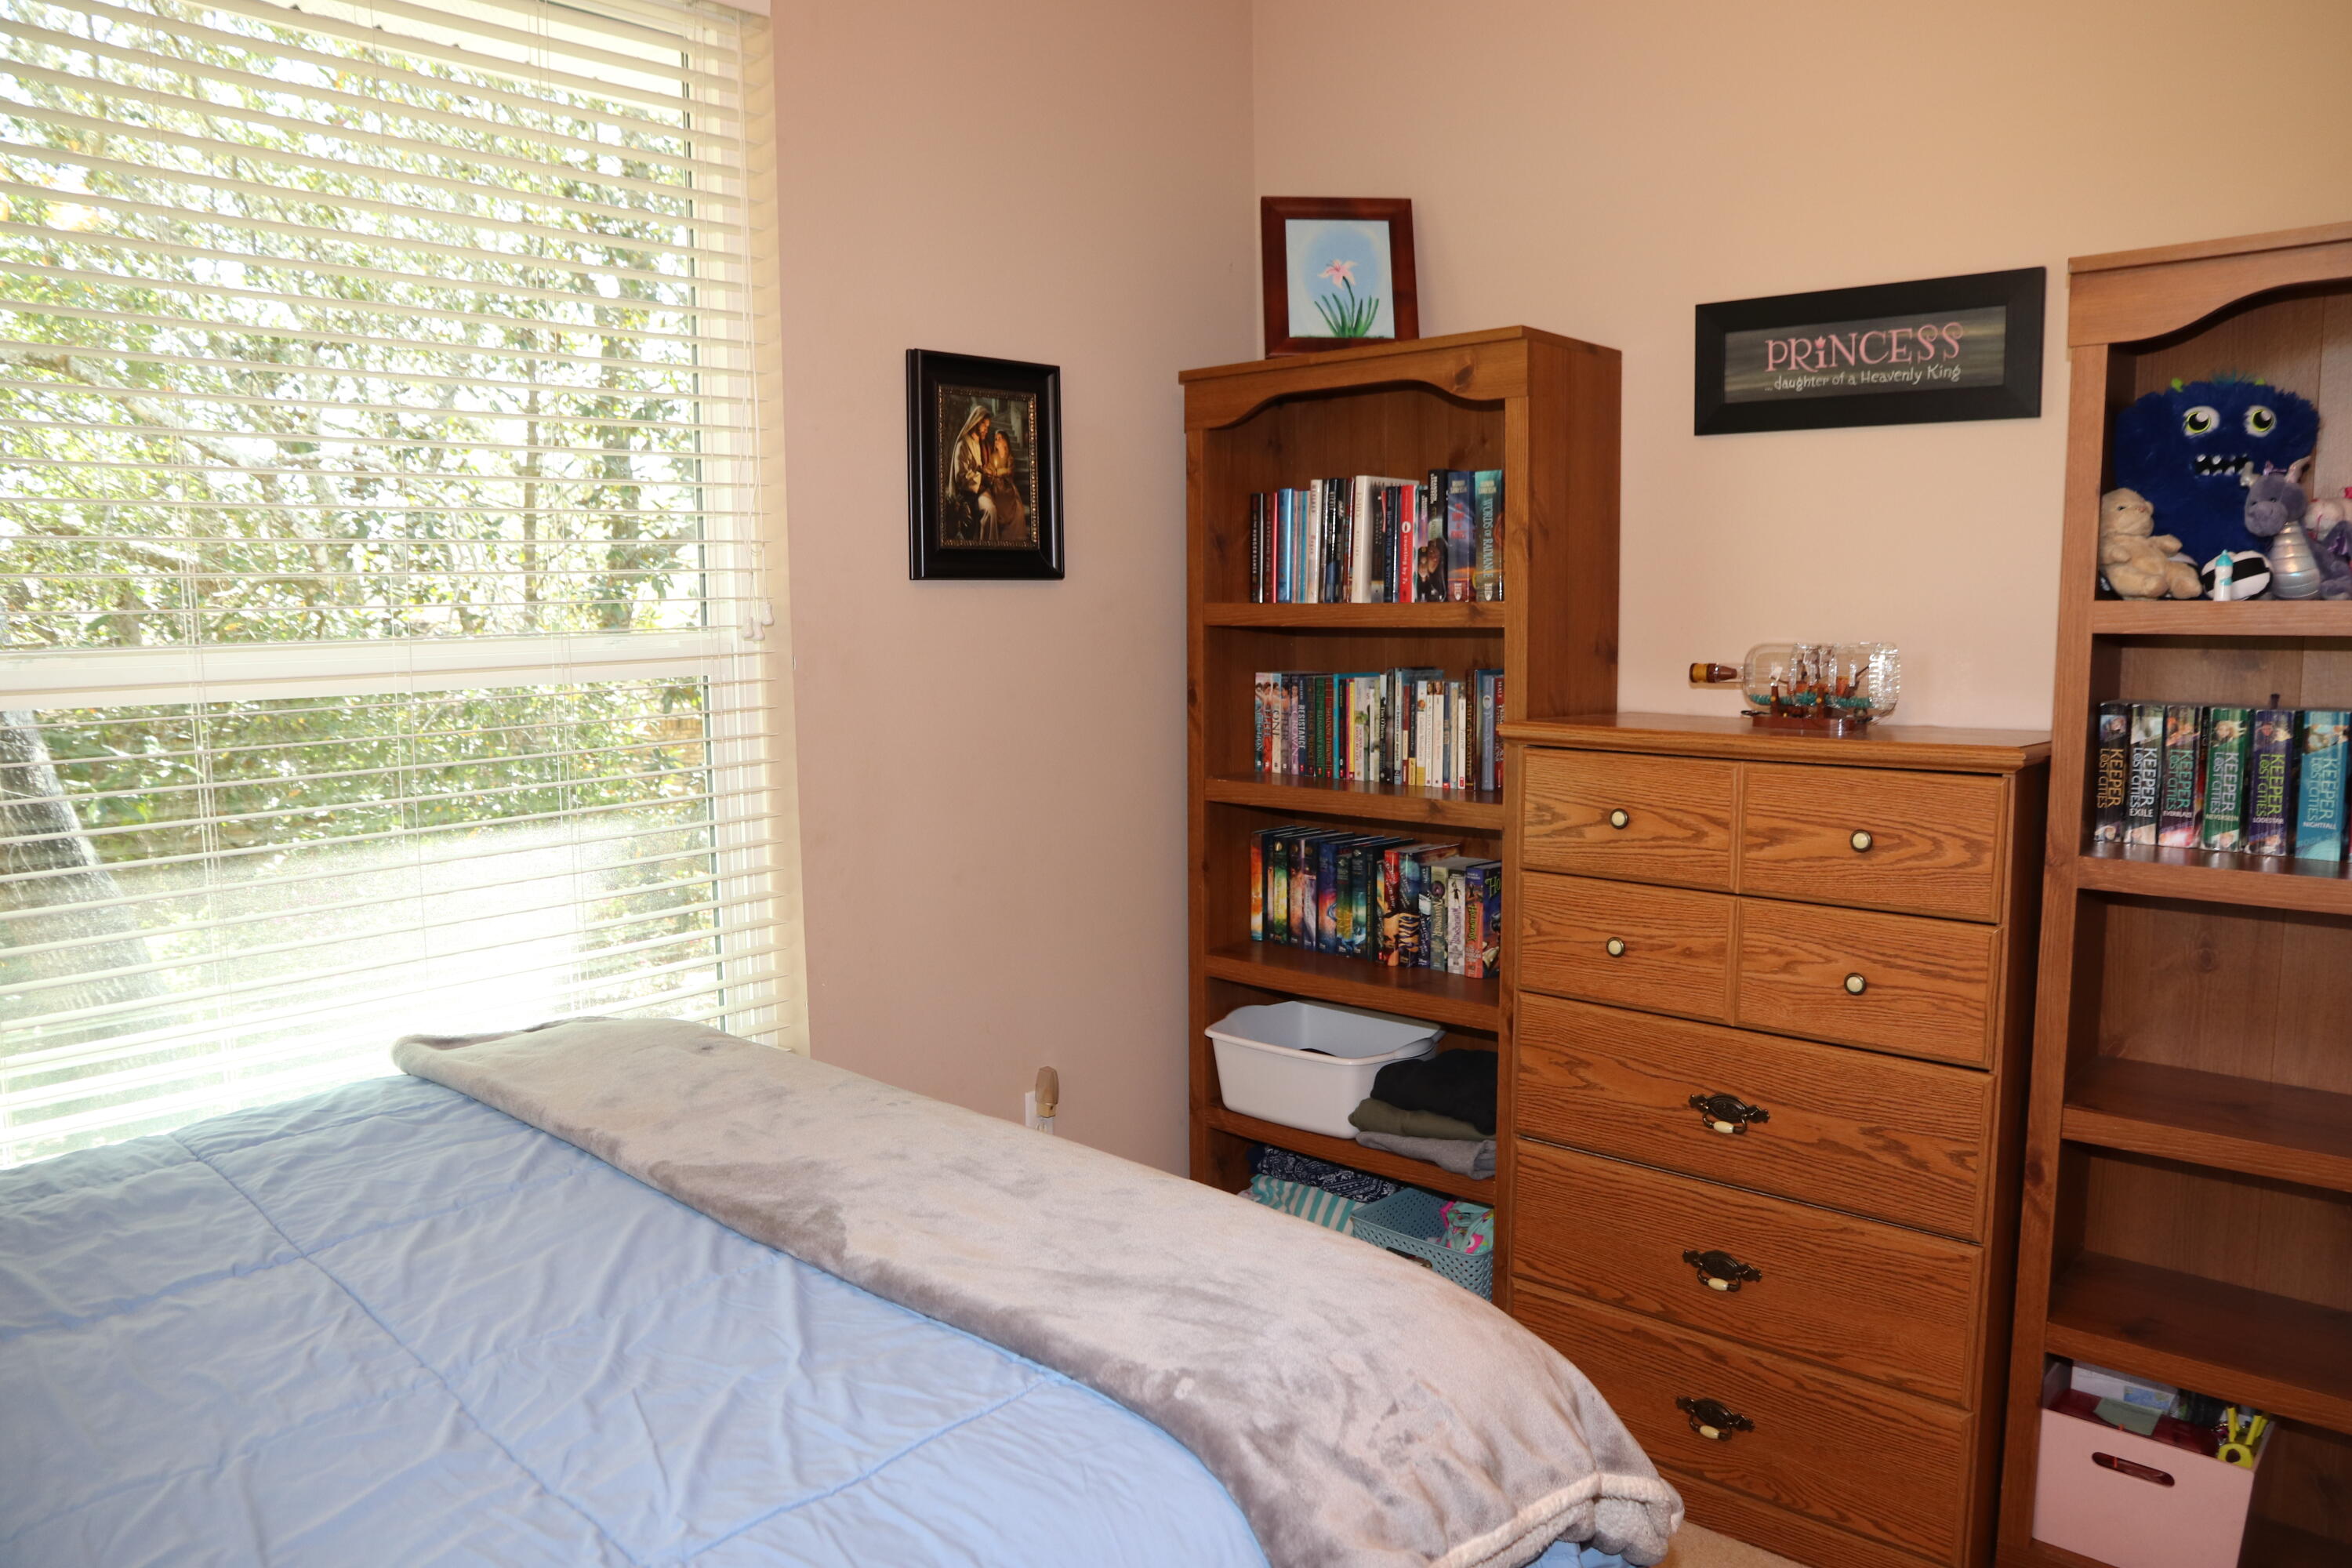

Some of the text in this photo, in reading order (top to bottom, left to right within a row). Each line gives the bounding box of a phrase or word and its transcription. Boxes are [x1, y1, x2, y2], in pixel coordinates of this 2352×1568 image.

[1831, 372, 1846, 386] of
[1847, 376, 1857, 386] a
[1860, 366, 1923, 385] Heavenly
[1926, 363, 1962, 383] King
[1483, 497, 1494, 528] WORDS
[1401, 567, 1408, 576] by
[1483, 539, 1494, 578] RADIANCE
[2096, 747, 2111, 808] LOST CITIES
[2108, 748, 2125, 808] KEEPER
[2129, 747, 2143, 808] LOST CITIES
[2140, 747, 2158, 807] KEEPER
[2166, 749, 2183, 811] LOST CITIES
[2176, 750, 2194, 810] KEEPER
[2209, 752, 2227, 814] LOST CITIES
[2220, 752, 2240, 812] KEEPER
[2255, 753, 2270, 817] LOST CITIES
[2267, 753, 2286, 816] KEEPER
[2307, 757, 2323, 822] LOST CITIES
[2318, 758, 2338, 821] KEEPER
[2129, 808, 2154, 818] EXILE
[1431, 899, 1443, 937] NEVERMOOR
